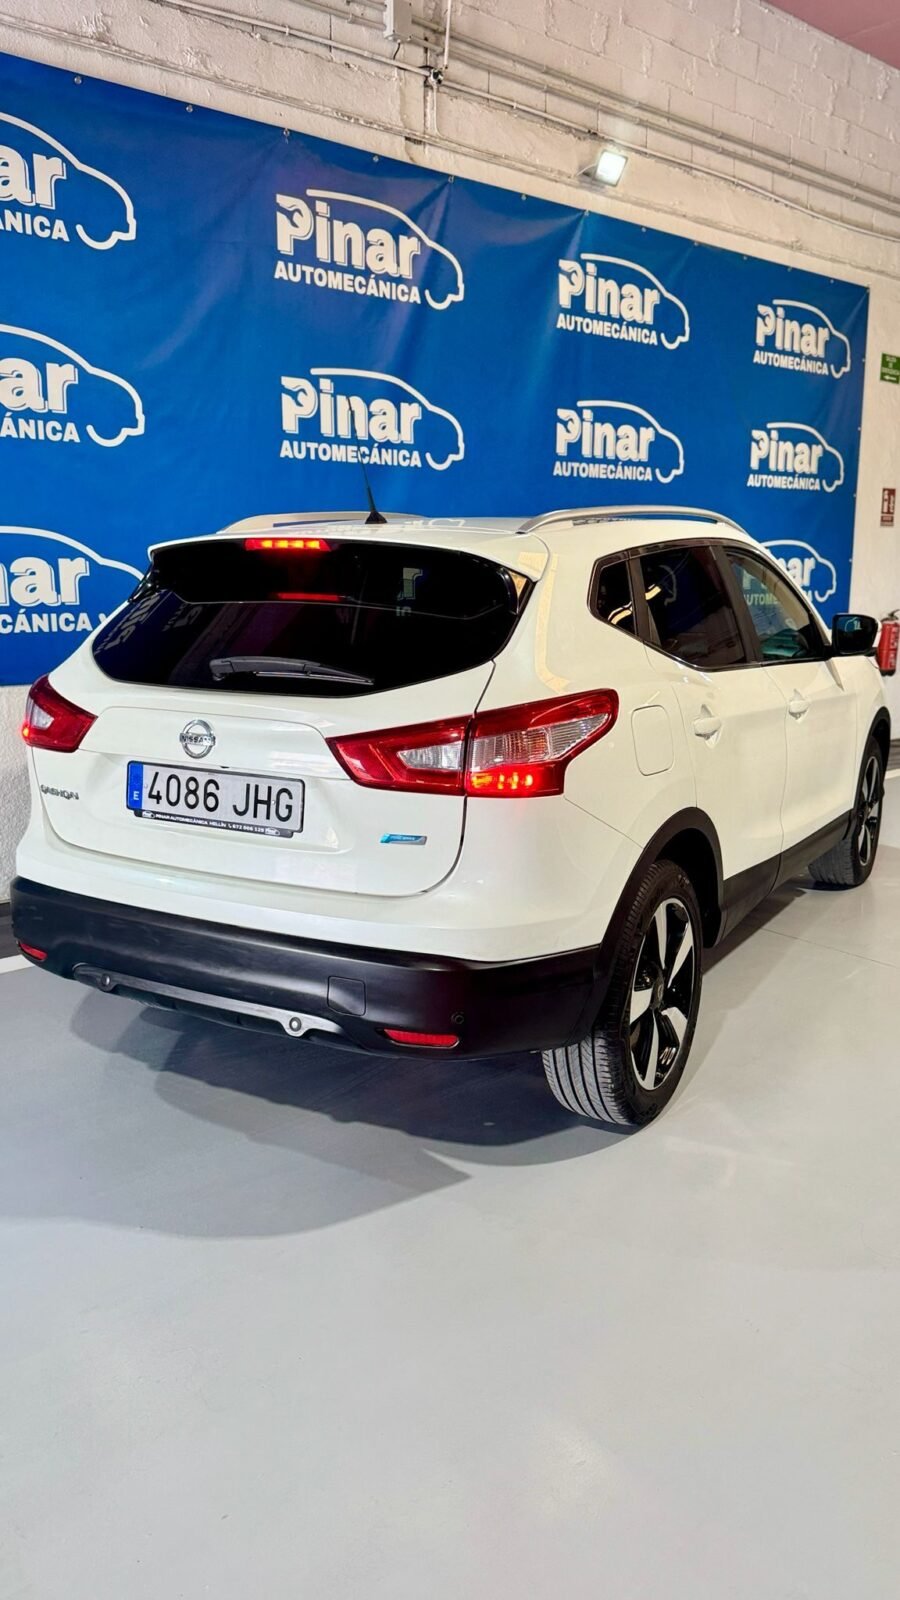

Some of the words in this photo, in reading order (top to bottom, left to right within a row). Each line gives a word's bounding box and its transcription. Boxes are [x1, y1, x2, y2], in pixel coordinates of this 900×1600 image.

[0, 209, 70, 242] NICA
[275, 193, 421, 279] Pinar
[274, 261, 422, 304] AUTOMECÁNICA
[558, 258, 660, 325] Pinar
[556, 313, 658, 346] AUTOMECÁNICA
[755, 303, 830, 358] Pinar
[753, 350, 829, 376] AUTOMECÁNICA
[280, 375, 422, 444] Pinar
[279, 439, 422, 467] AUTOMECÁNICA
[555, 408, 655, 462] Pinar
[750, 429, 823, 474] Pinar
[552, 461, 653, 481] AUTOMECÁNICA
[746, 473, 820, 491] AUTOMECÁNICA
[0, 556, 90, 607] ar
[133, 791, 140, 801] E
[148, 771, 220, 812] 4086
[232, 783, 293, 822] JHG
